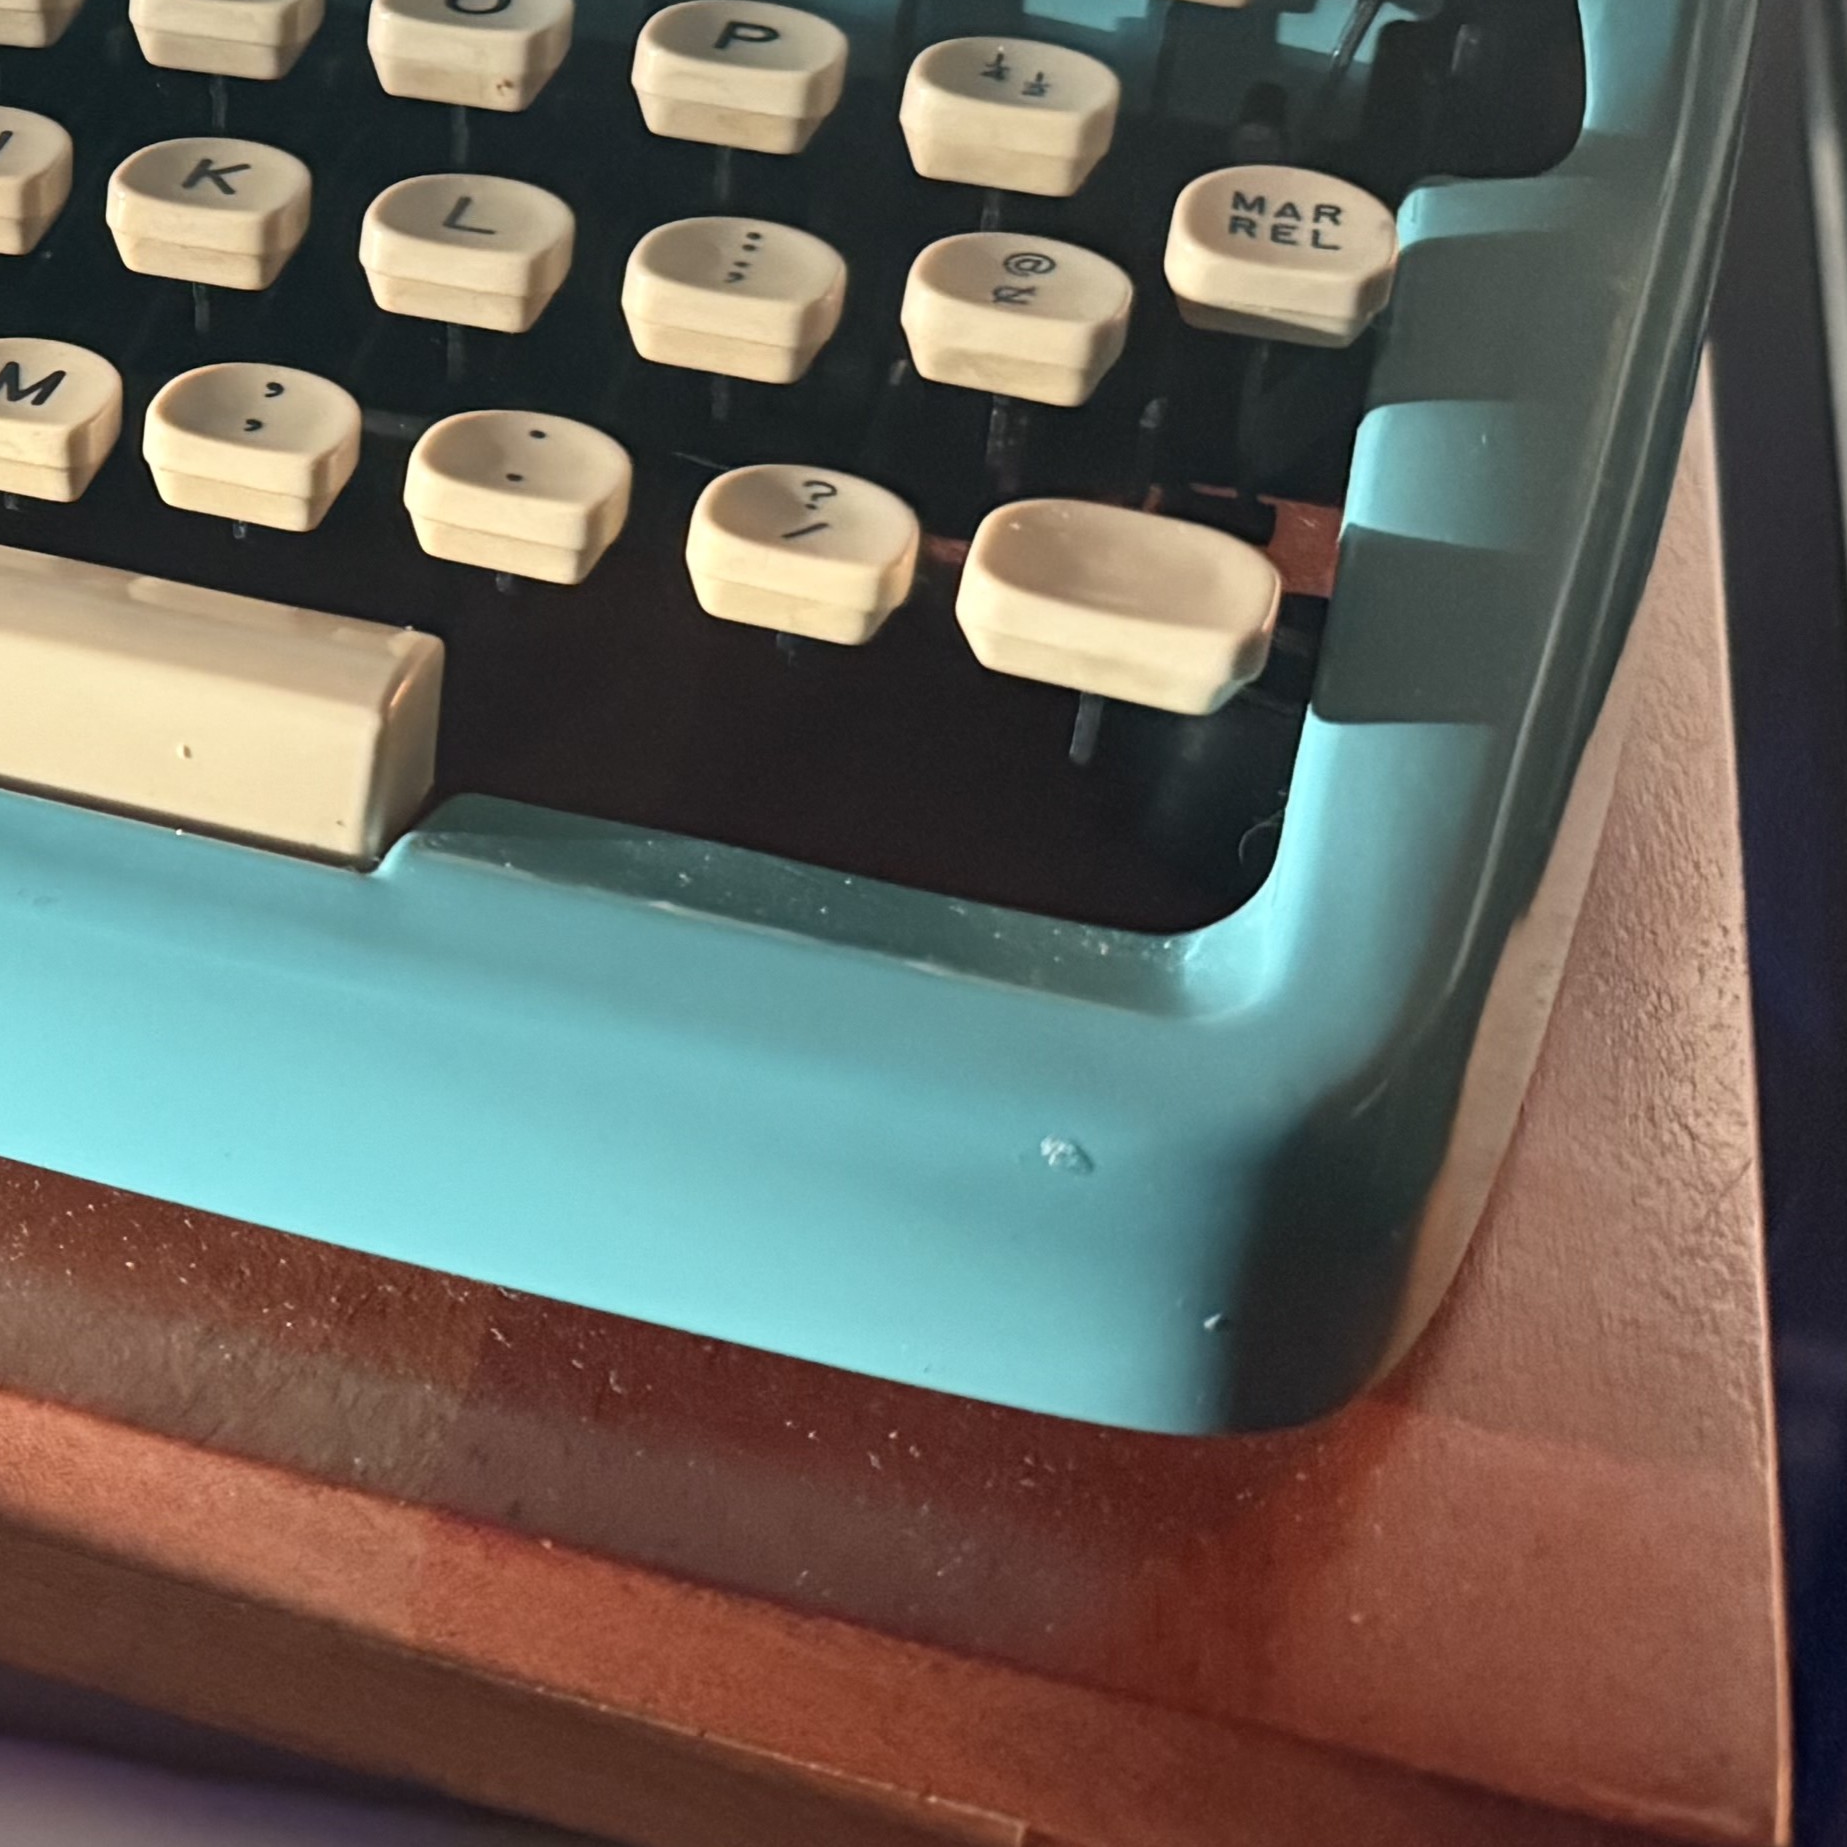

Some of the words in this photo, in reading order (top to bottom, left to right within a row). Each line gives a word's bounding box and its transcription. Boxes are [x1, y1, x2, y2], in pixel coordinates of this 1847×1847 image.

[713, 20, 781, 50] P
[181, 158, 251, 195] K
[442, 195, 496, 235] L
[1230, 191, 1343, 226] MAR
[1227, 215, 1342, 251] REL
[1003, 252, 1058, 278] @
[802, 480, 838, 511] ?
[781, 522, 830, 542] /
